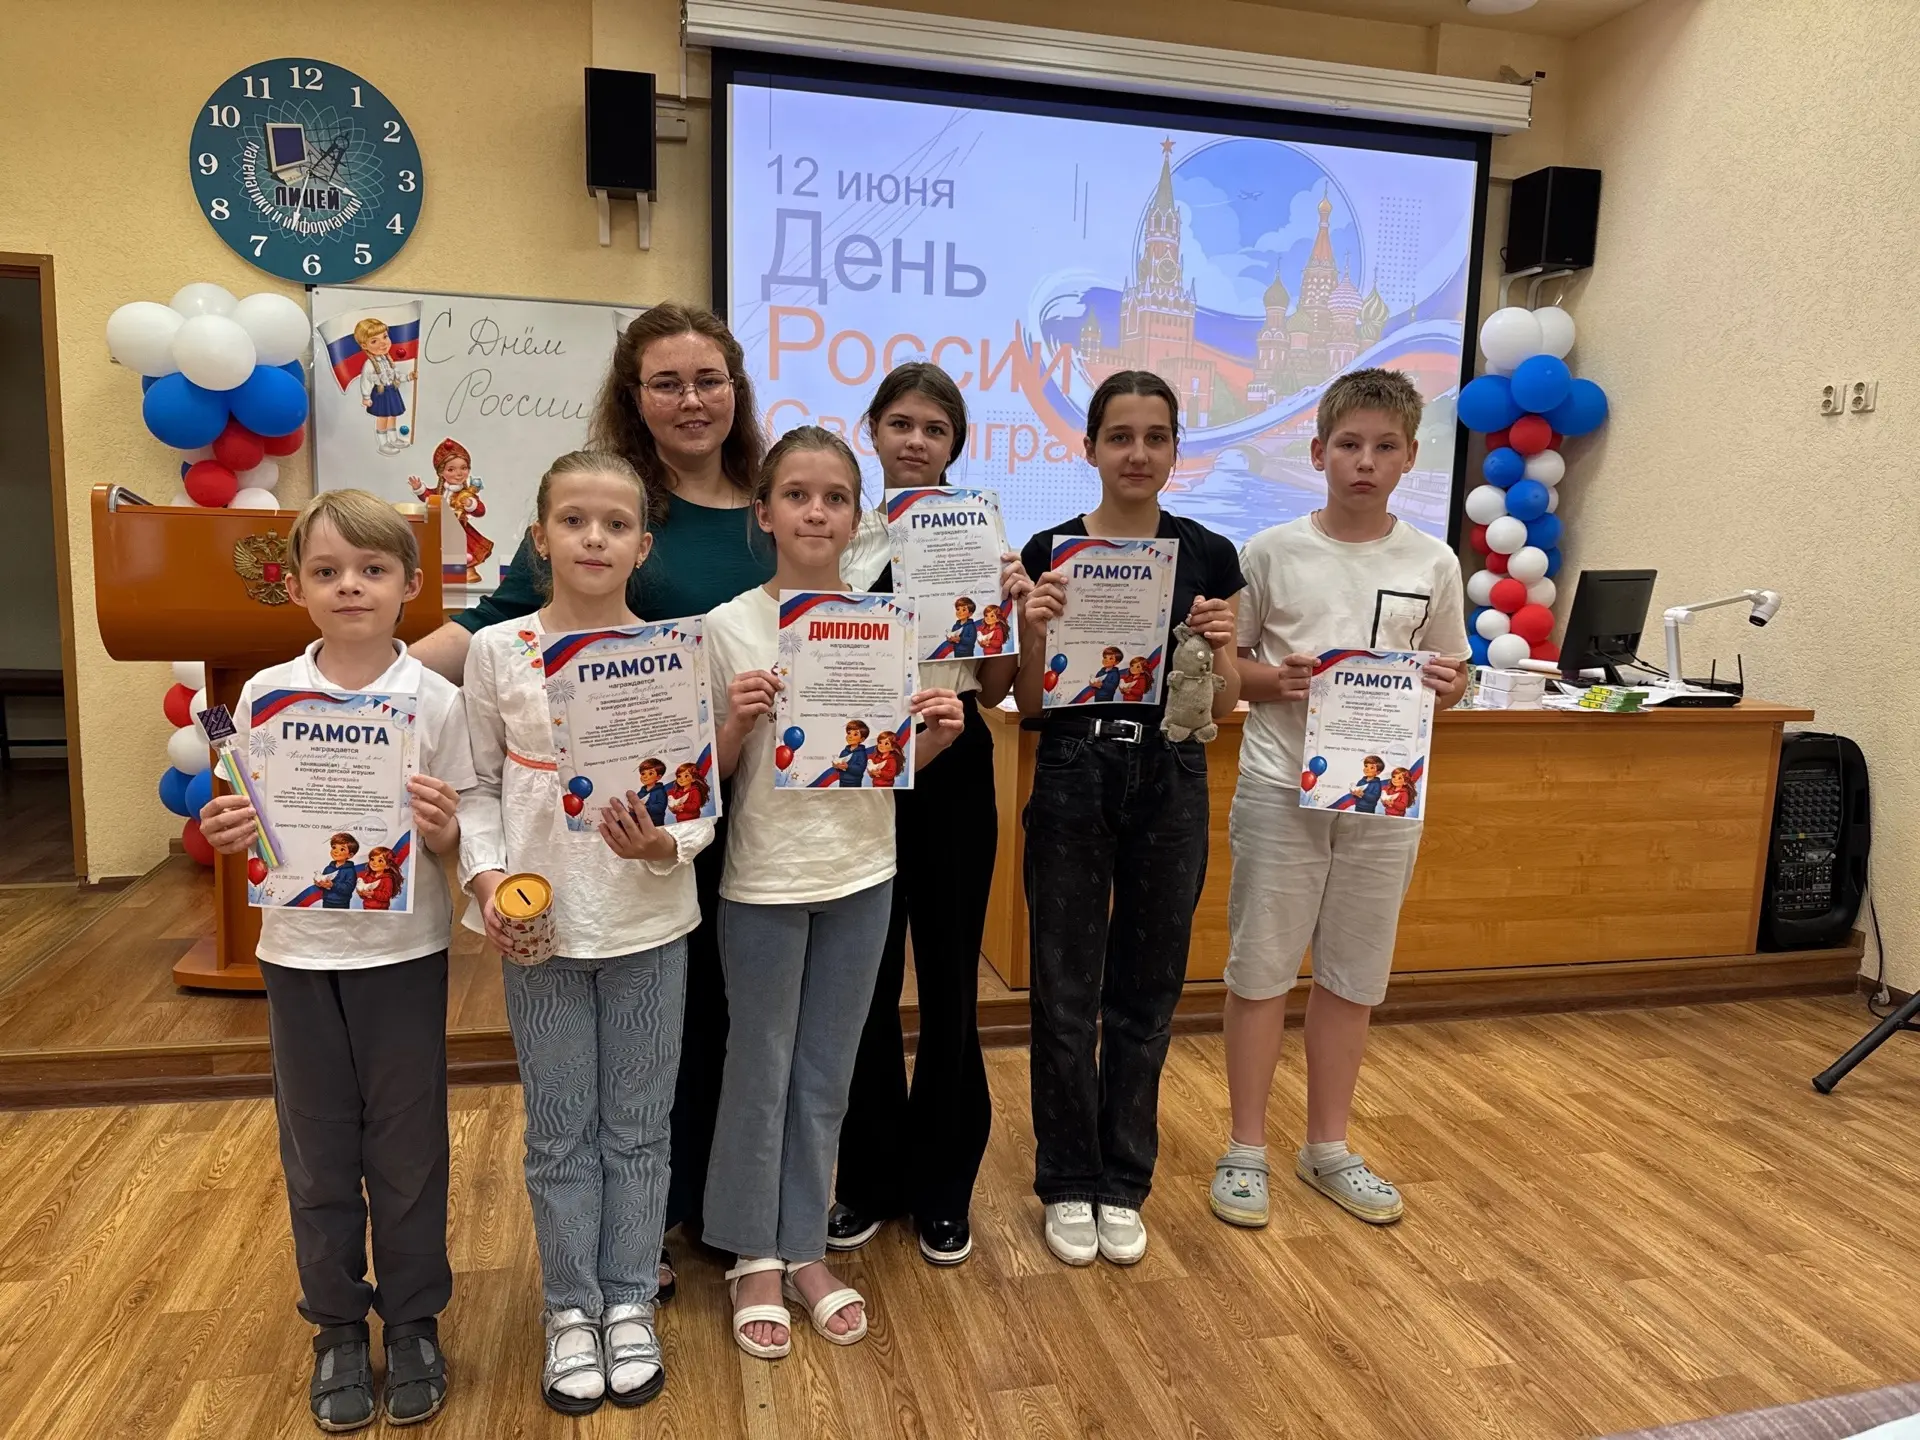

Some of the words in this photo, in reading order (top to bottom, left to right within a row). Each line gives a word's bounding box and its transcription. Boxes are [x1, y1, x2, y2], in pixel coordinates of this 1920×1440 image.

[242, 76, 273, 99] 11
[289, 67, 323, 90] 12
[351, 86, 364, 108] 1
[208, 105, 240, 128] 10
[383, 121, 401, 143] 2
[198, 153, 218, 175] 9
[398, 170, 415, 192] 3
[767, 154, 819, 197] 12
[838, 170, 954, 209] июня
[211, 198, 230, 220] 8
[275, 187, 340, 212] ЛИЦЕЙ
[272, 211, 282, 223] и
[386, 213, 404, 234] 4
[250, 235, 268, 257] 7
[354, 243, 372, 265] 5
[761, 208, 987, 305] День
[303, 254, 321, 275] 6
[425, 308, 455, 364] С
[468, 316, 566, 356] Днём
[767, 305, 1073, 395] России
[446, 369, 590, 424] России
[912, 512, 987, 528] ГРАМОТА
[1074, 564, 1152, 580] ГРАМОТА
[808, 622, 889, 641] ДИПЛОМ
[578, 653, 682, 682] ГРАМОТА
[1335, 672, 1412, 690] ГРАМОТА
[283, 722, 389, 745] ГРАМОТА
